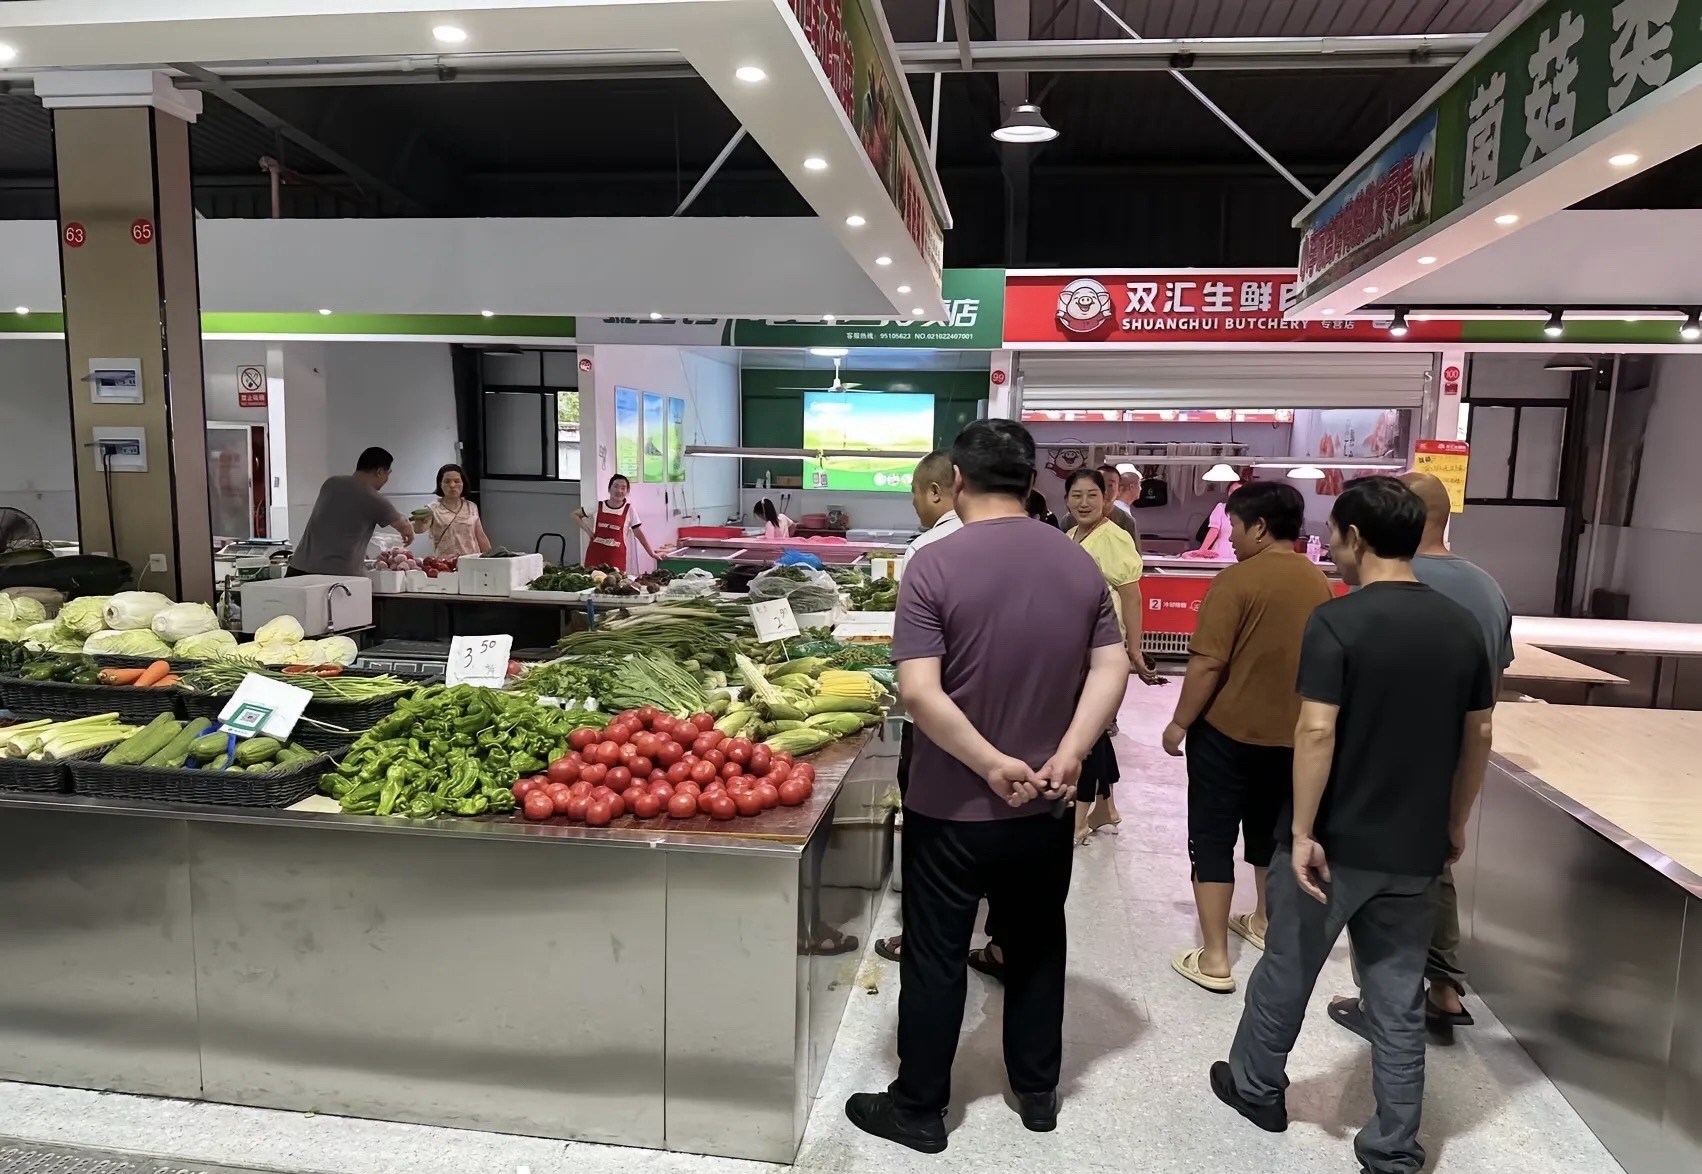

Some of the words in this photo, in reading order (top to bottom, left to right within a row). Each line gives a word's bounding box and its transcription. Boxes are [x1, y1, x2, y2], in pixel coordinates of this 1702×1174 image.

[66, 227, 84, 243] 63
[133, 224, 151, 240] 65
[1122, 317, 1219, 330] SHUANGHUI
[1225, 317, 1309, 329] BUTCHERY
[992, 372, 1005, 382] 99
[1445, 370, 1459, 379] 100
